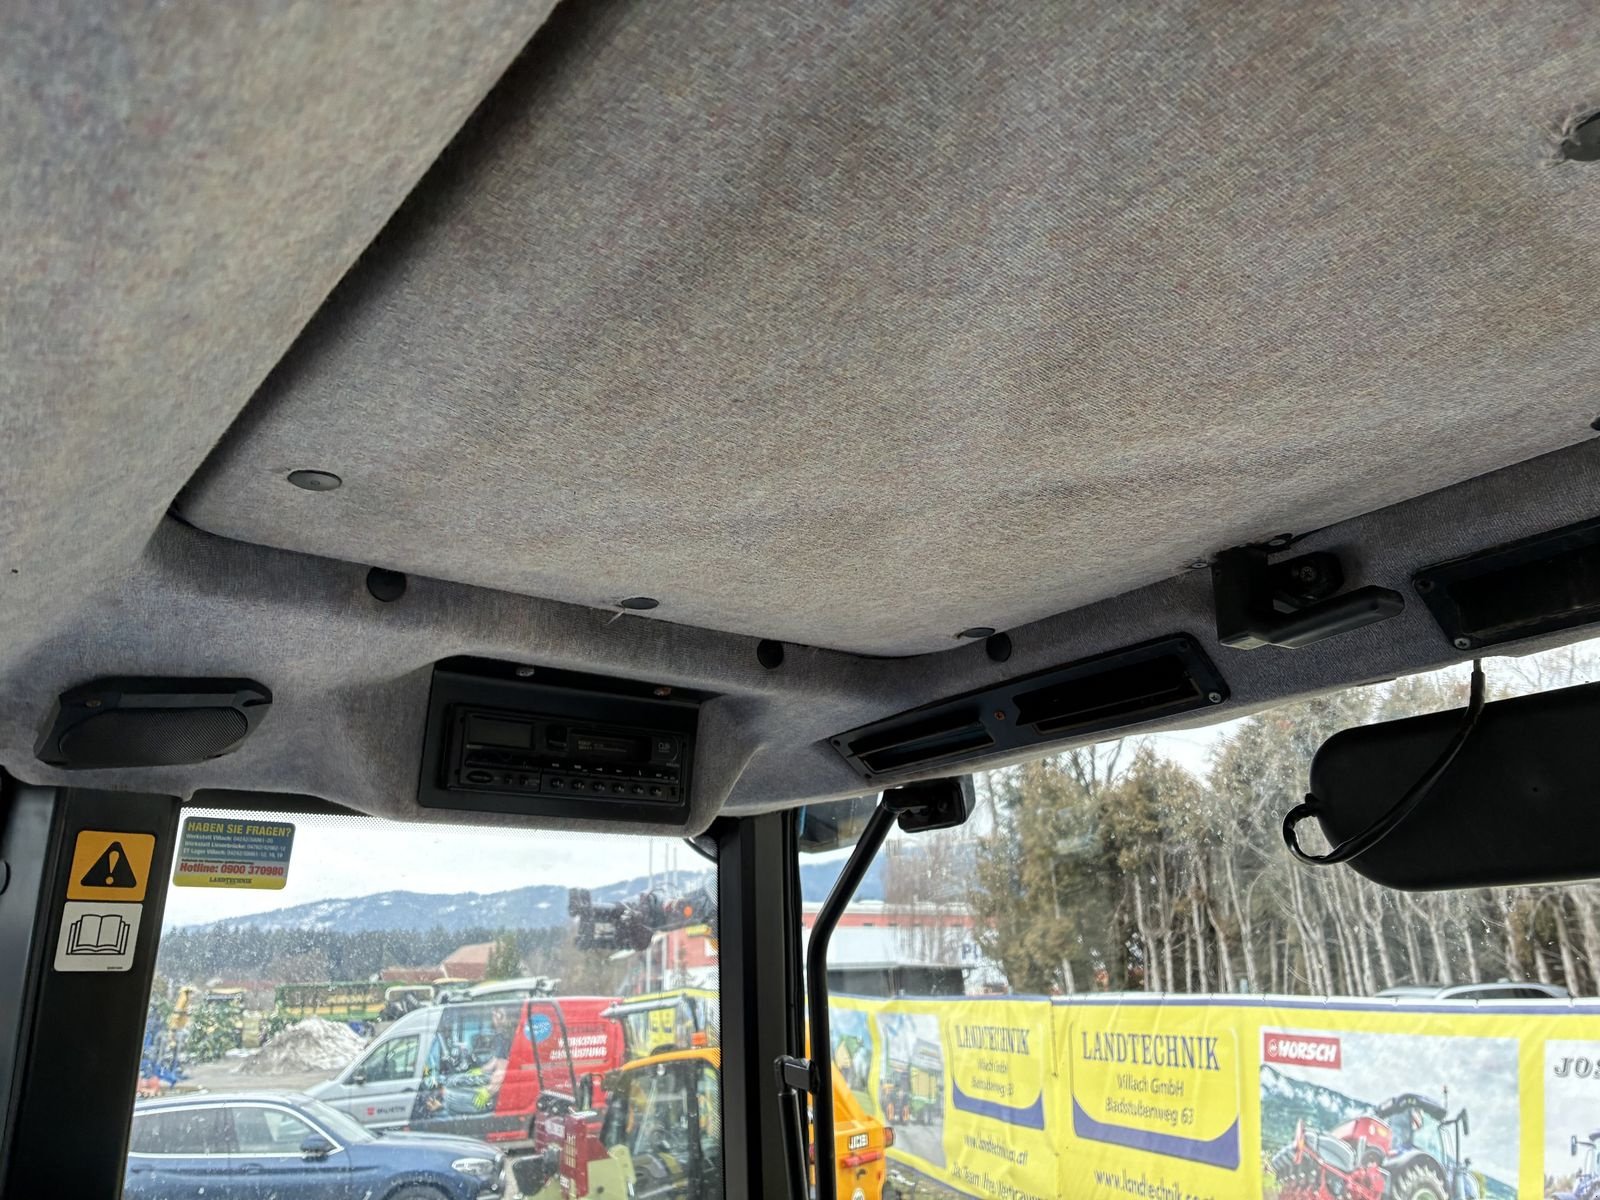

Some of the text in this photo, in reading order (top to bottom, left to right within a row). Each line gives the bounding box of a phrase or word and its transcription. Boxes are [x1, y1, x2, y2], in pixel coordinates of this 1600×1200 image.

[188, 822, 292, 838] HABEN SIE FRAGEN?
[180, 862, 284, 877] Hotline: 0900 370980
[557, 1034, 608, 1049] WRKSTATT
[1081, 1031, 1220, 1071] LANDTECHNIK
[1278, 1040, 1337, 1062] HORSCH
[1116, 1073, 1185, 1097] Villach GmbH
[1105, 1096, 1178, 1126] Badstubenweg
[848, 1134, 868, 1149] JCB
